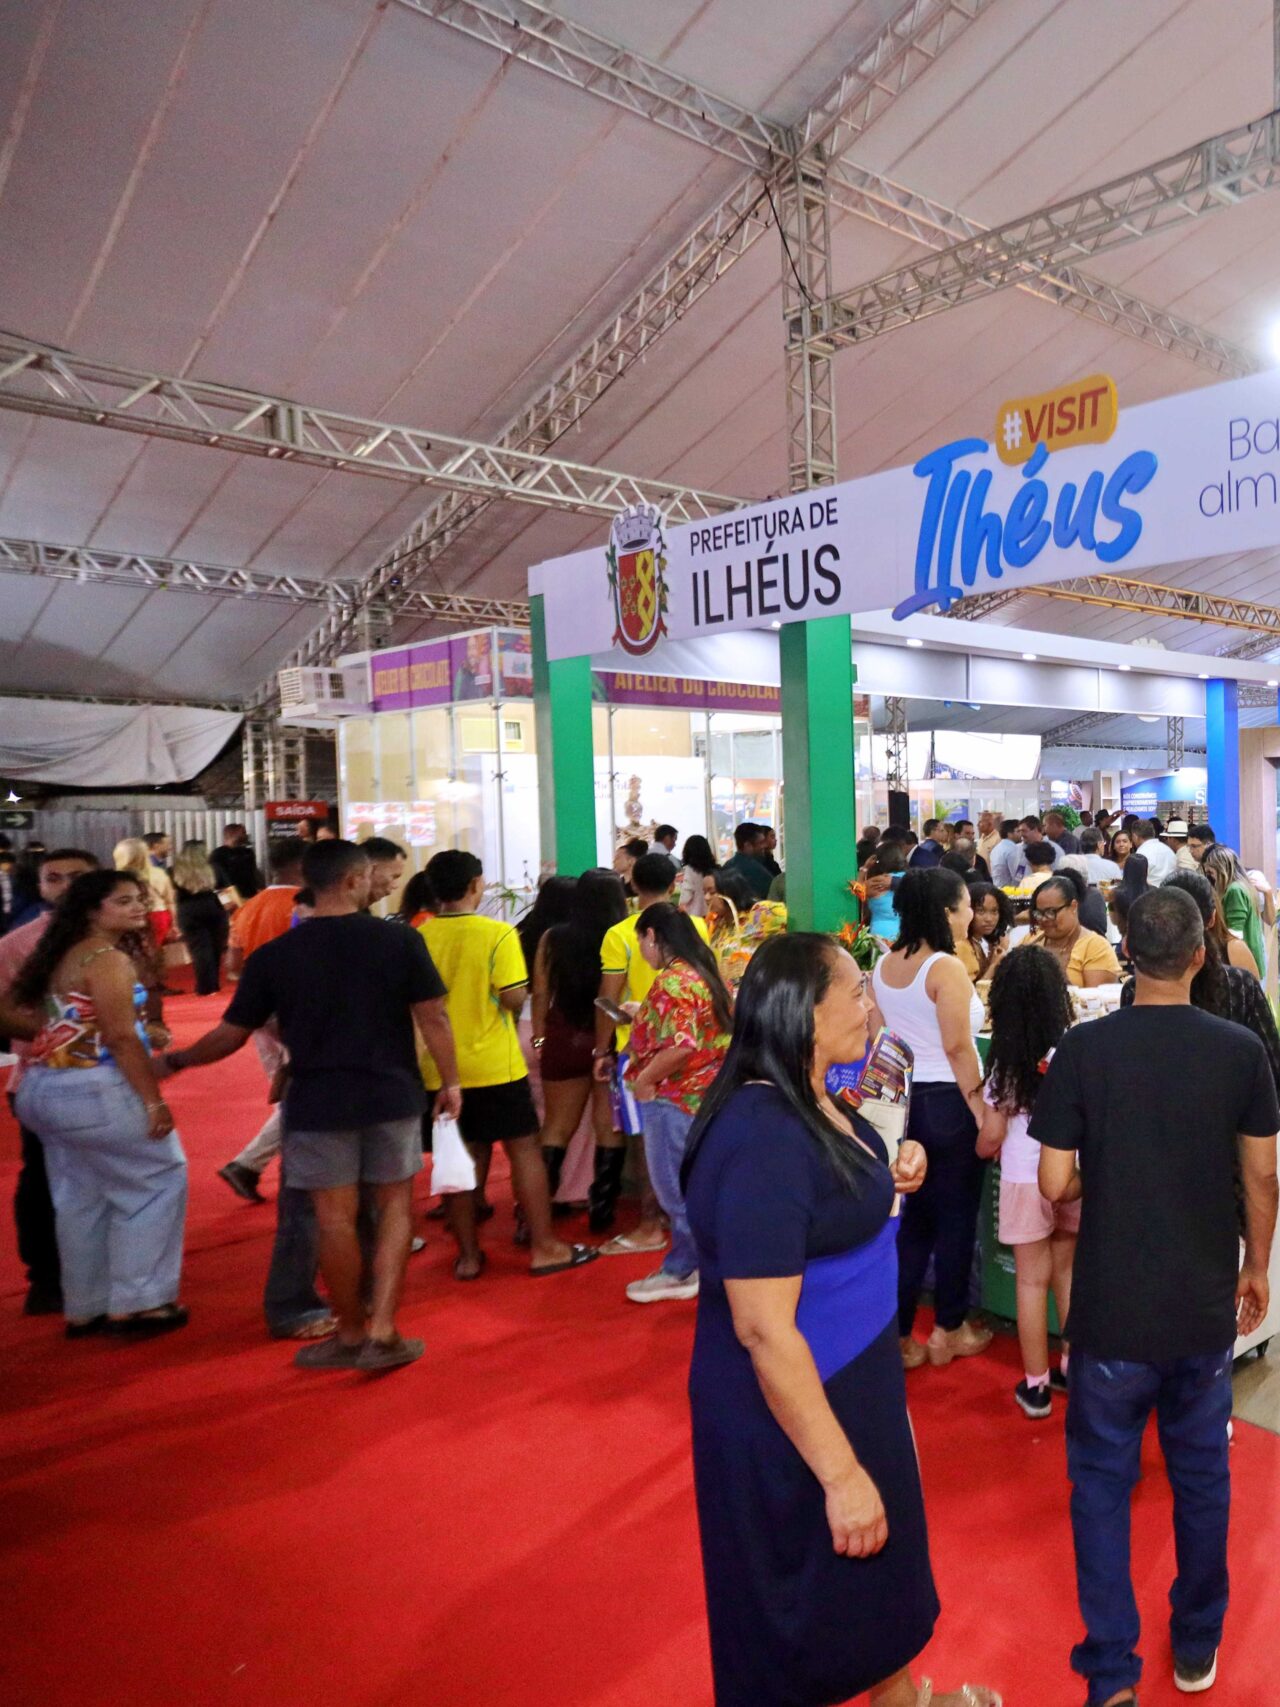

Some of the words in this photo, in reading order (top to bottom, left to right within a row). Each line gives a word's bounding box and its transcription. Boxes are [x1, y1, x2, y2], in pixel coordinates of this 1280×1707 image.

[1003, 386, 1108, 450] #VISIT
[690, 506, 805, 556] PREFEITURA
[810, 497, 838, 529] DE
[892, 437, 1158, 621] Ilhéus
[692, 541, 841, 626] ILHÉUS
[615, 672, 678, 694] ATELIER
[708, 681, 780, 700] CHOCOLAT
[276, 803, 317, 816] SAÍDA
